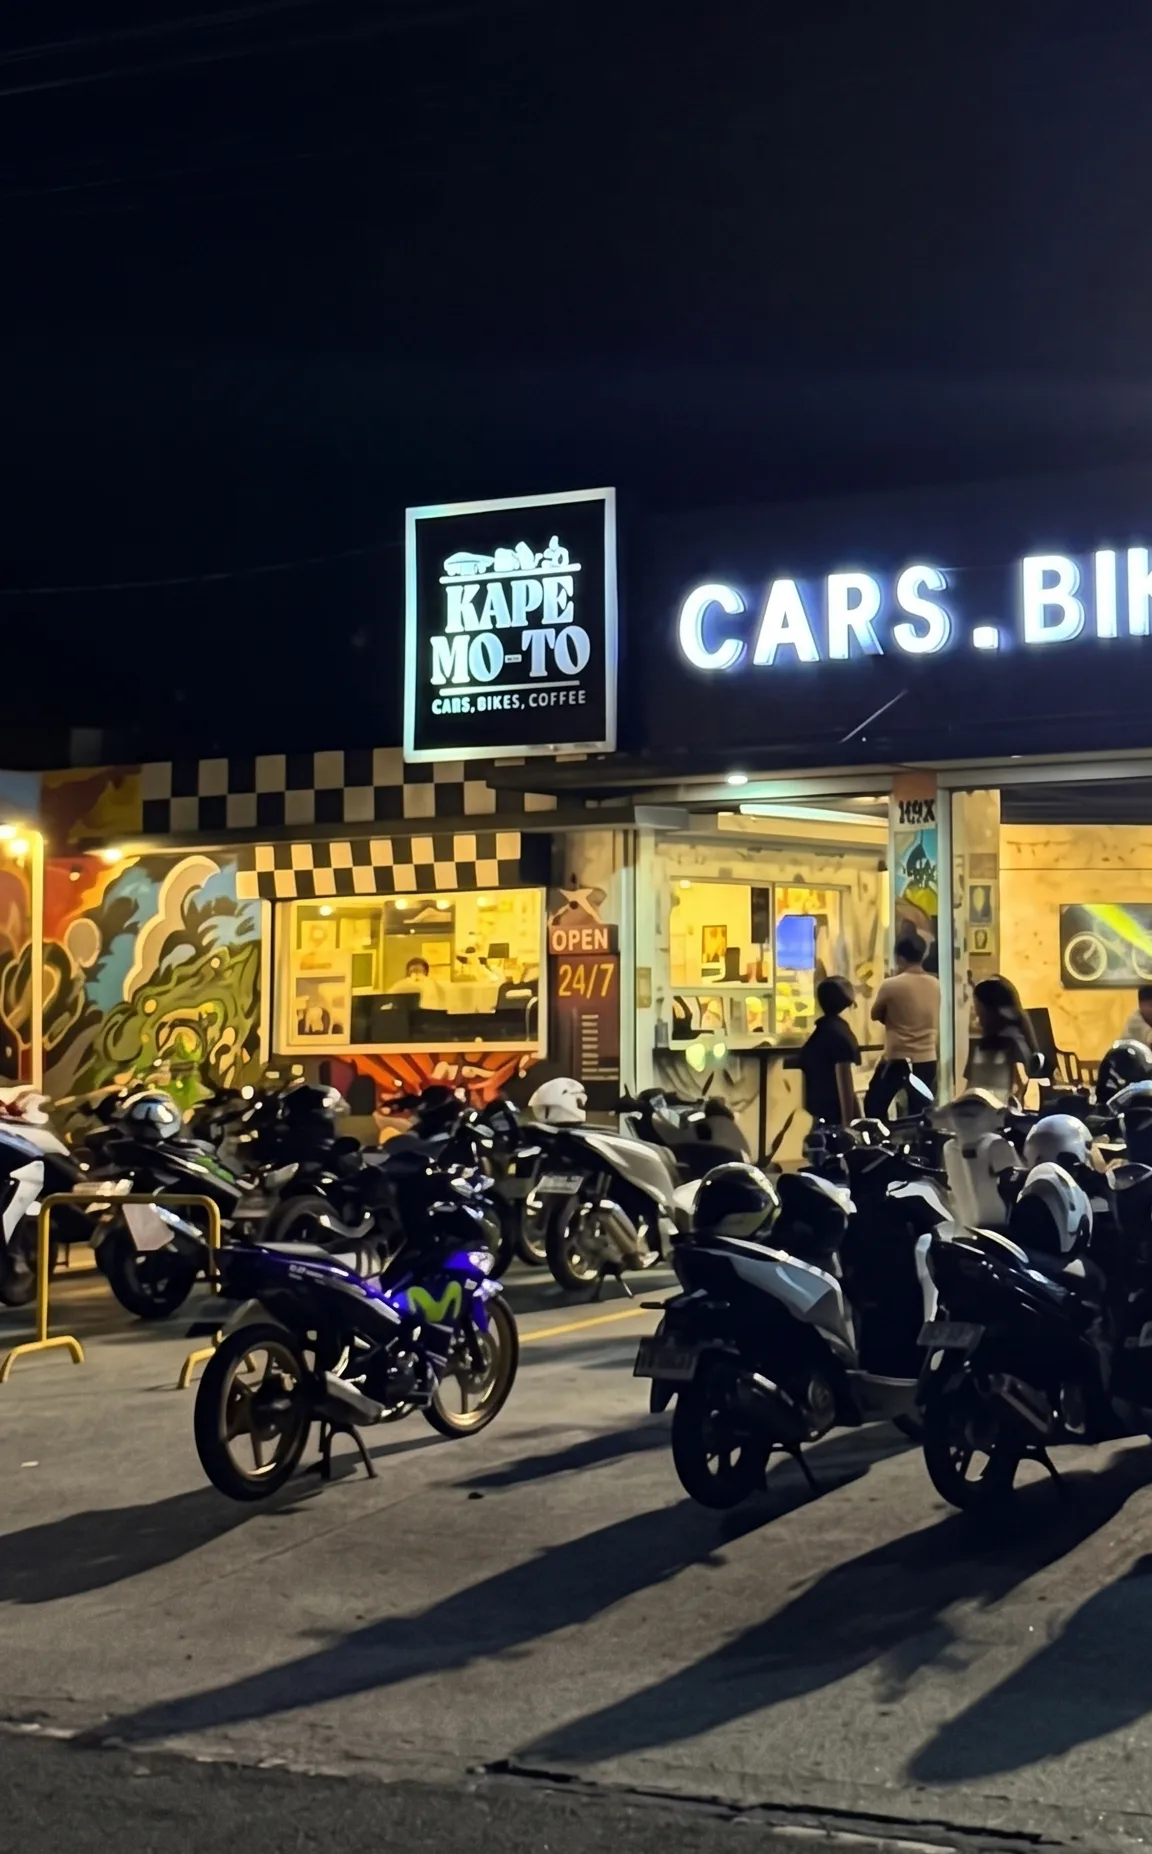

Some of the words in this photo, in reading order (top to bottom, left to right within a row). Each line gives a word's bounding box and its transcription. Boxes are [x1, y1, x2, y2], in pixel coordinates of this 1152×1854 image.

[445, 575, 574, 633] KAPE
[430, 625, 590, 685] MO-TO
[476, 694, 525, 712] BIKES,
[528, 690, 586, 707] COFFEE
[552, 928, 608, 951] OPEN
[558, 963, 615, 999] 24/7
